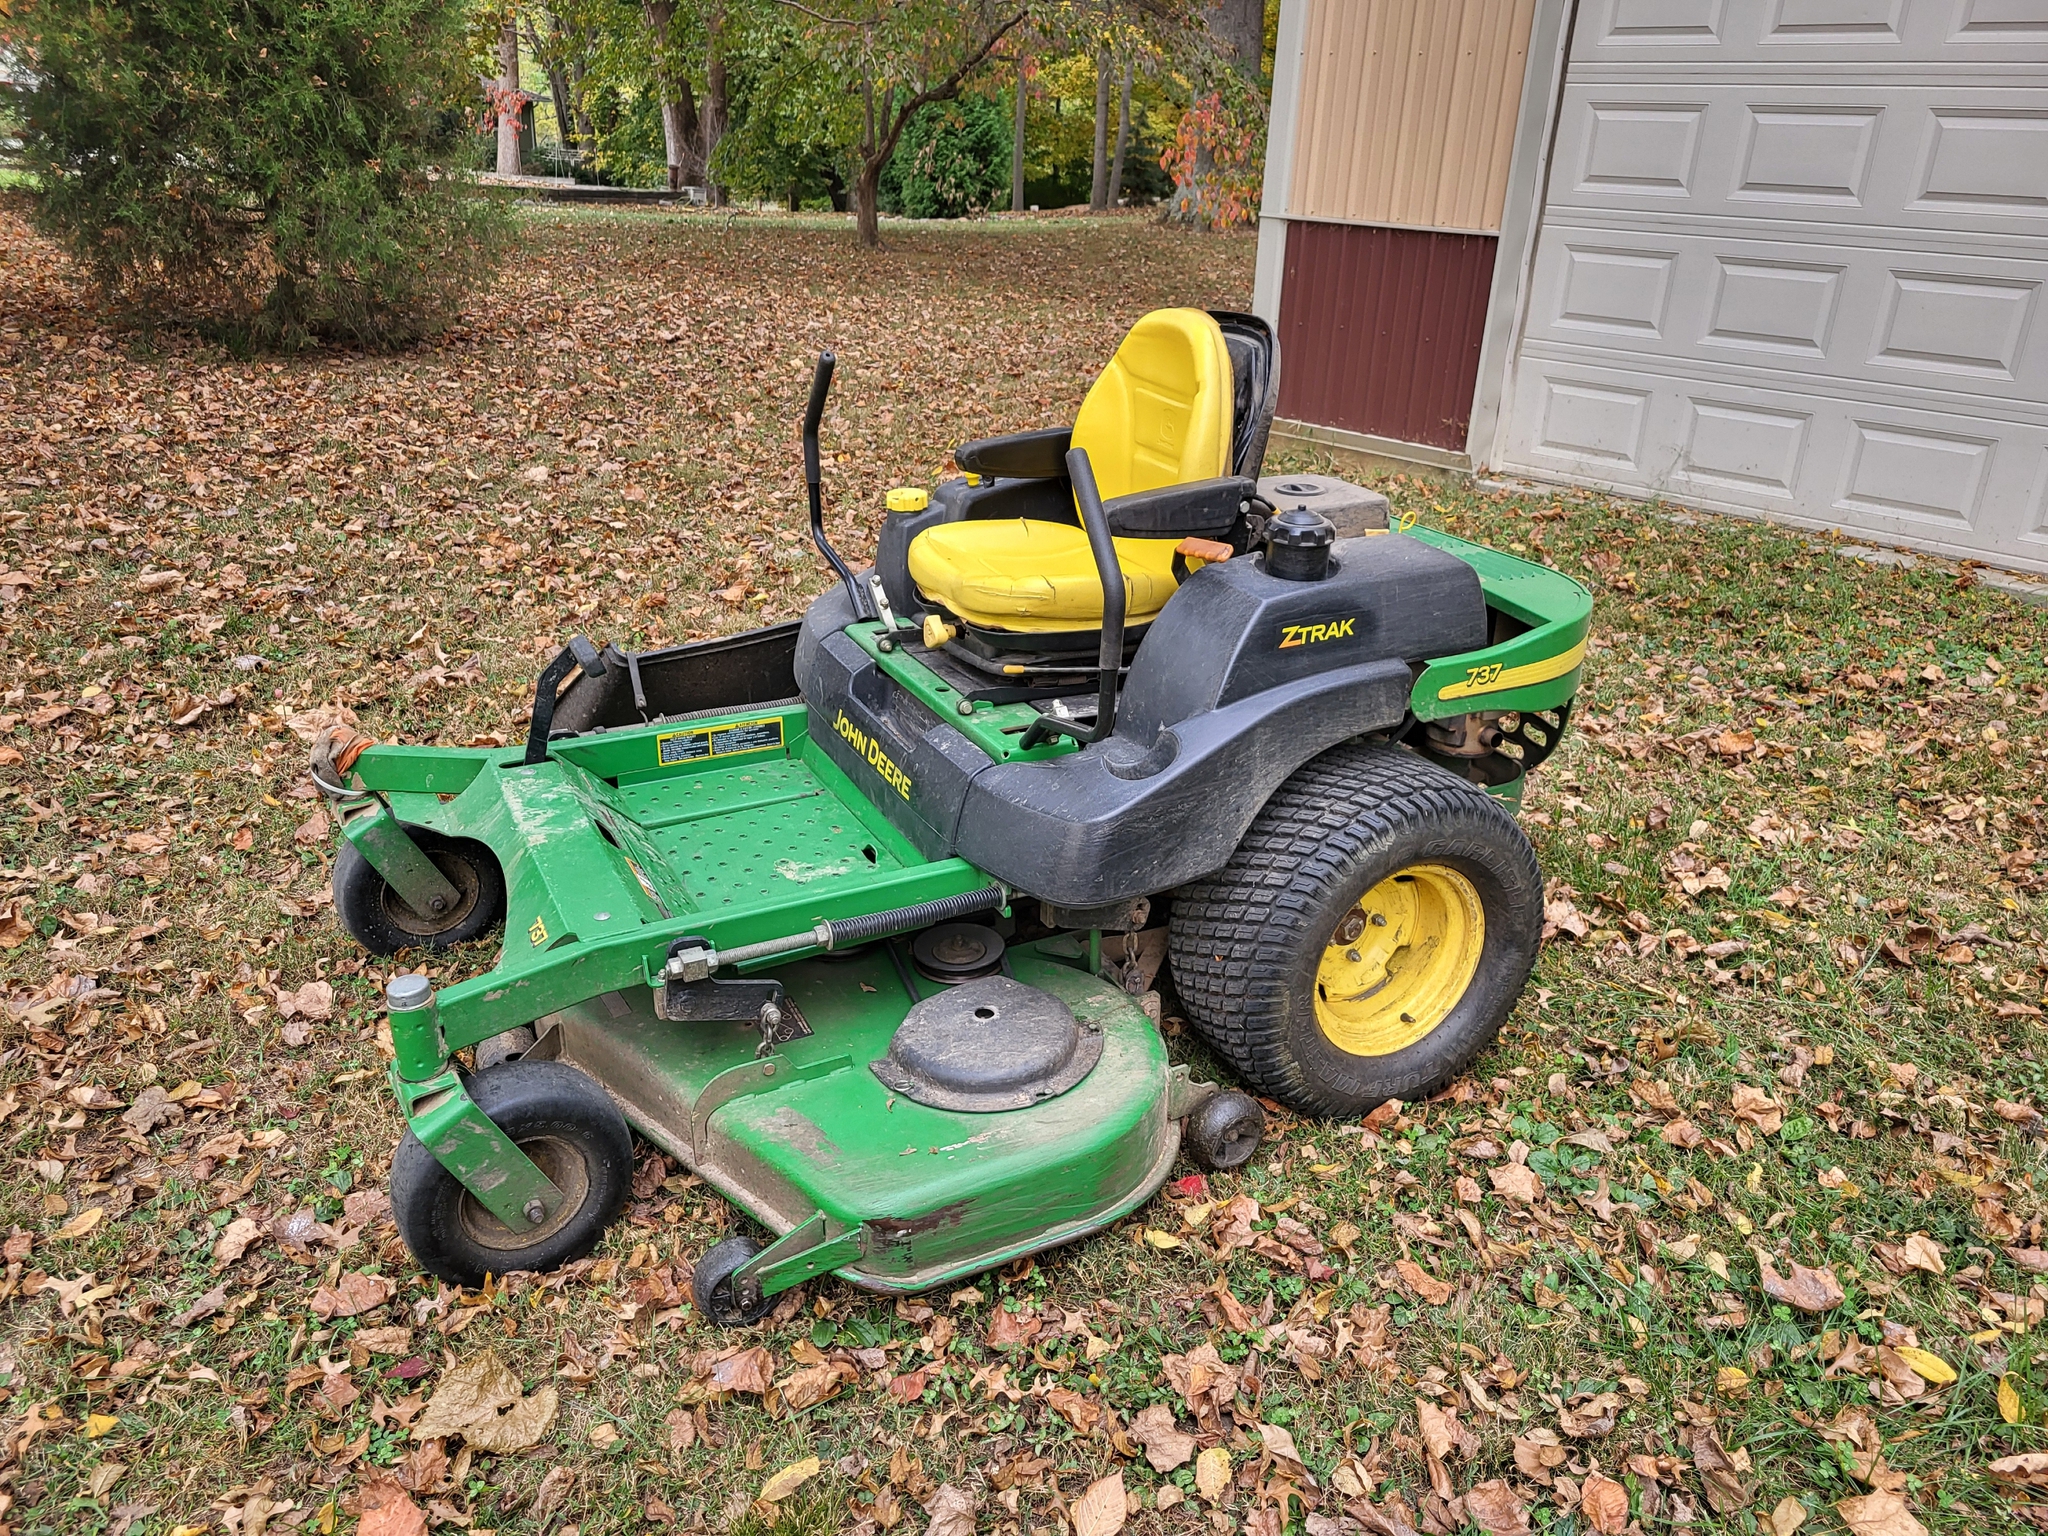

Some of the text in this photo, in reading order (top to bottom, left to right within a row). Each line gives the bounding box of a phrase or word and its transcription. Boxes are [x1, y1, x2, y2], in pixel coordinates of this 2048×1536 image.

[1278, 617, 1356, 649] ZTRAK
[1465, 663, 1503, 688] 737
[832, 708, 868, 756] JOHN
[867, 736, 912, 801] DEERE
[1422, 838, 1527, 921] CARLISLE
[527, 914, 549, 948] 737
[1361, 1061, 1441, 1098] TURF
